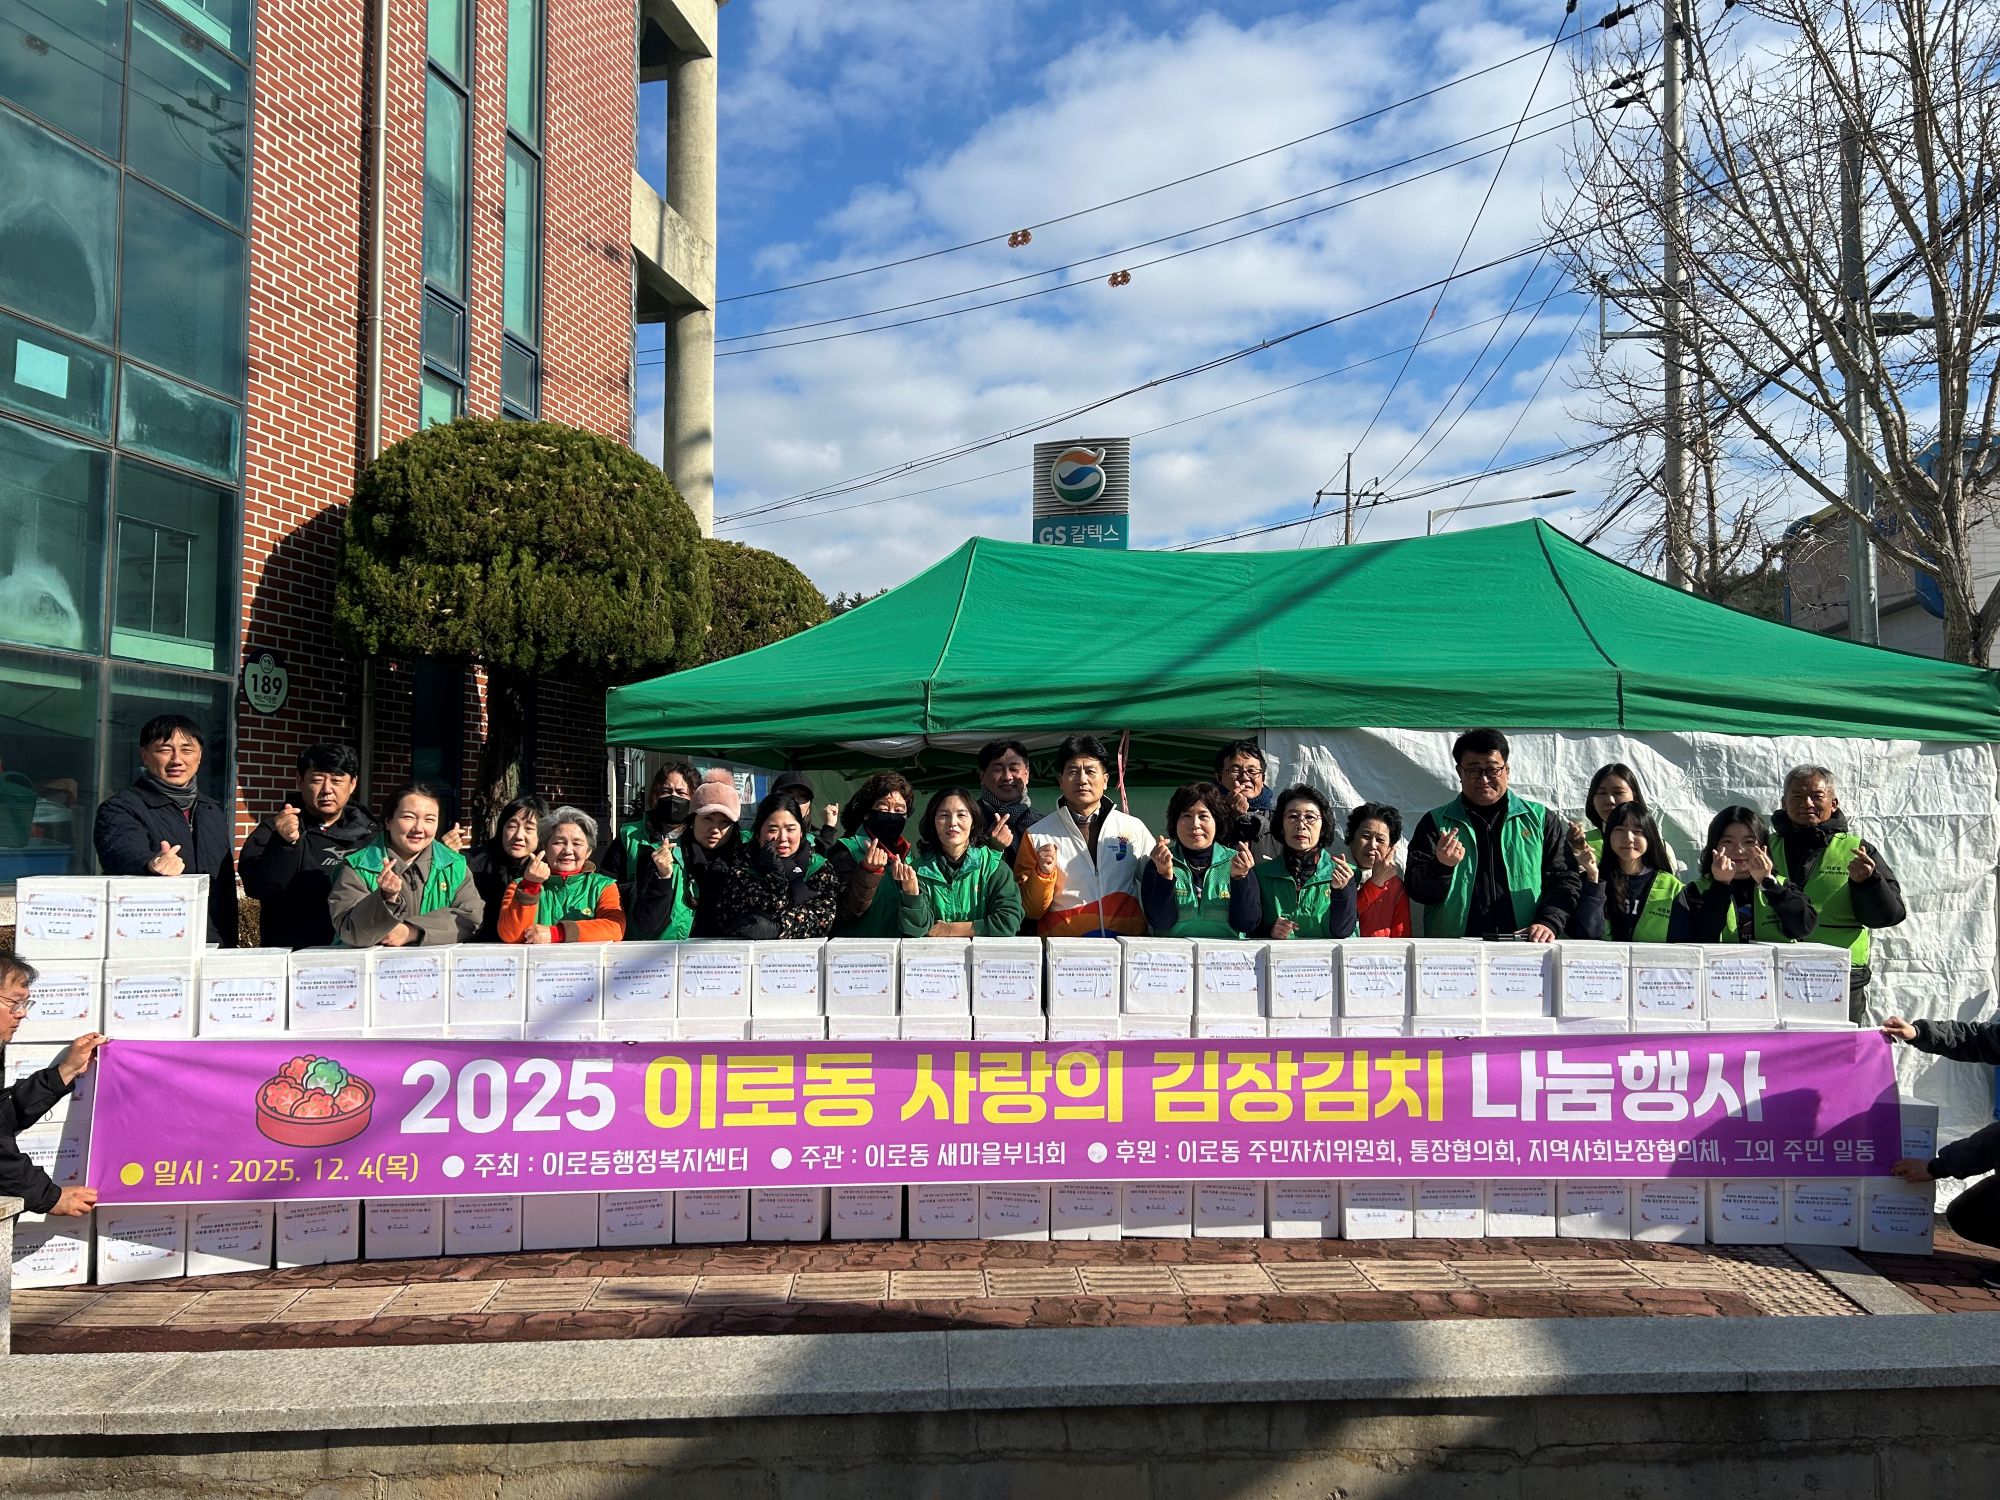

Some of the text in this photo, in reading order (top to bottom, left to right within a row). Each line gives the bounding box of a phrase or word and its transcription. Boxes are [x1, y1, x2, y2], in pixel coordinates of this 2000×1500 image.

[1039, 524, 1120, 545] GS 칼텍스
[251, 673, 283, 696] 189
[399, 1049, 1767, 1134] 2025 이로동 사랑의 김장김치 나눔행사
[473, 1152, 520, 1179] 주최
[542, 1147, 748, 1177] 이로동행정복지센터
[800, 1144, 845, 1170] 주관
[864, 1143, 930, 1169] 이로동
[936, 1140, 1066, 1167] 새마을부녀회
[1115, 1139, 1157, 1164] 후원
[1177, 1140, 1241, 1164] 이로동
[1247, 1138, 1402, 1166] 주민자치위원회,
[1409, 1138, 1521, 1166] 통장협의회,
[1528, 1138, 1726, 1165] 지역사회보장협의체,
[1734, 1139, 1775, 1162] 그외
[1783, 1139, 1824, 1162] 주민
[1833, 1139, 1873, 1162] 일동
[153, 1159, 203, 1186] 일시
[226, 1158, 301, 1183] 2025.
[314, 1158, 349, 1181] 12.
[357, 1152, 419, 1184] 4(목)
